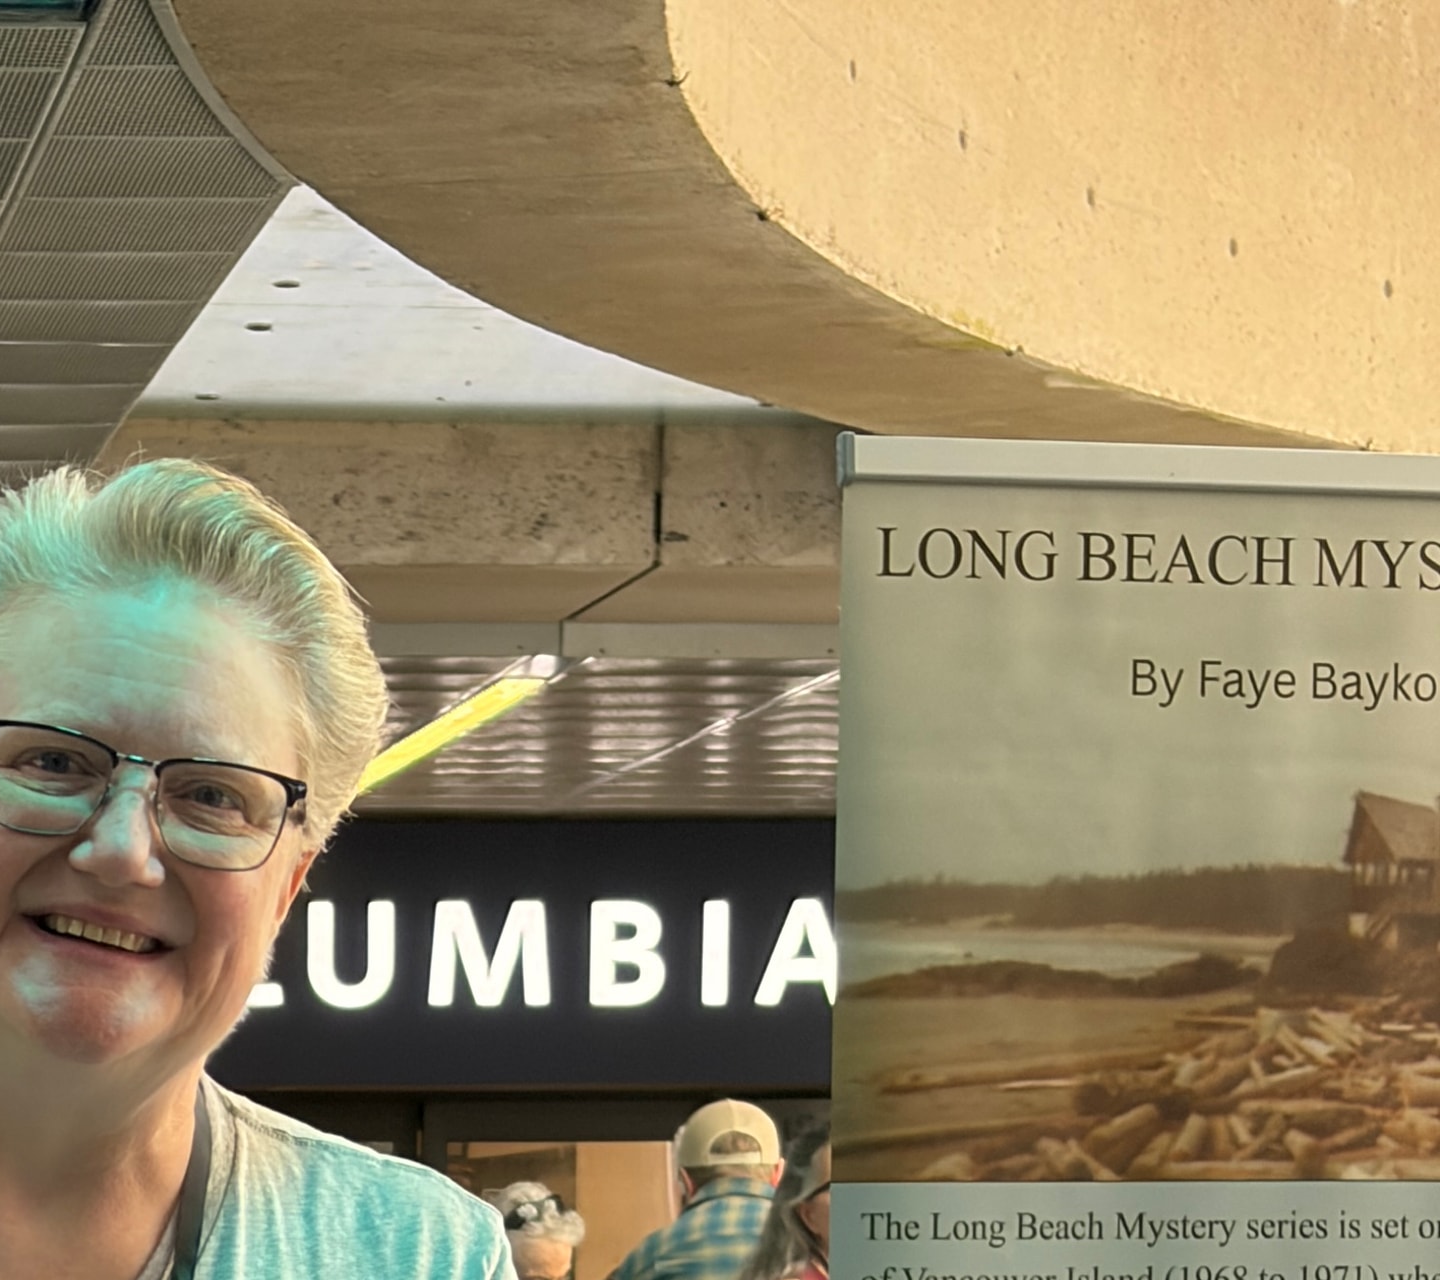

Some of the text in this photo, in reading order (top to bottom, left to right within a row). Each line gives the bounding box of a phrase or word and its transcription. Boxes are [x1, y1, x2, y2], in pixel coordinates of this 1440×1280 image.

[876, 526, 1058, 580] LONG
[1077, 532, 1294, 586] BEACH
[1130, 659, 1438, 710] By Faye Bayko
[260, 898, 837, 1009] UMBIA
[861, 1210, 1410, 1248] The Long Beach Mystery series is set
